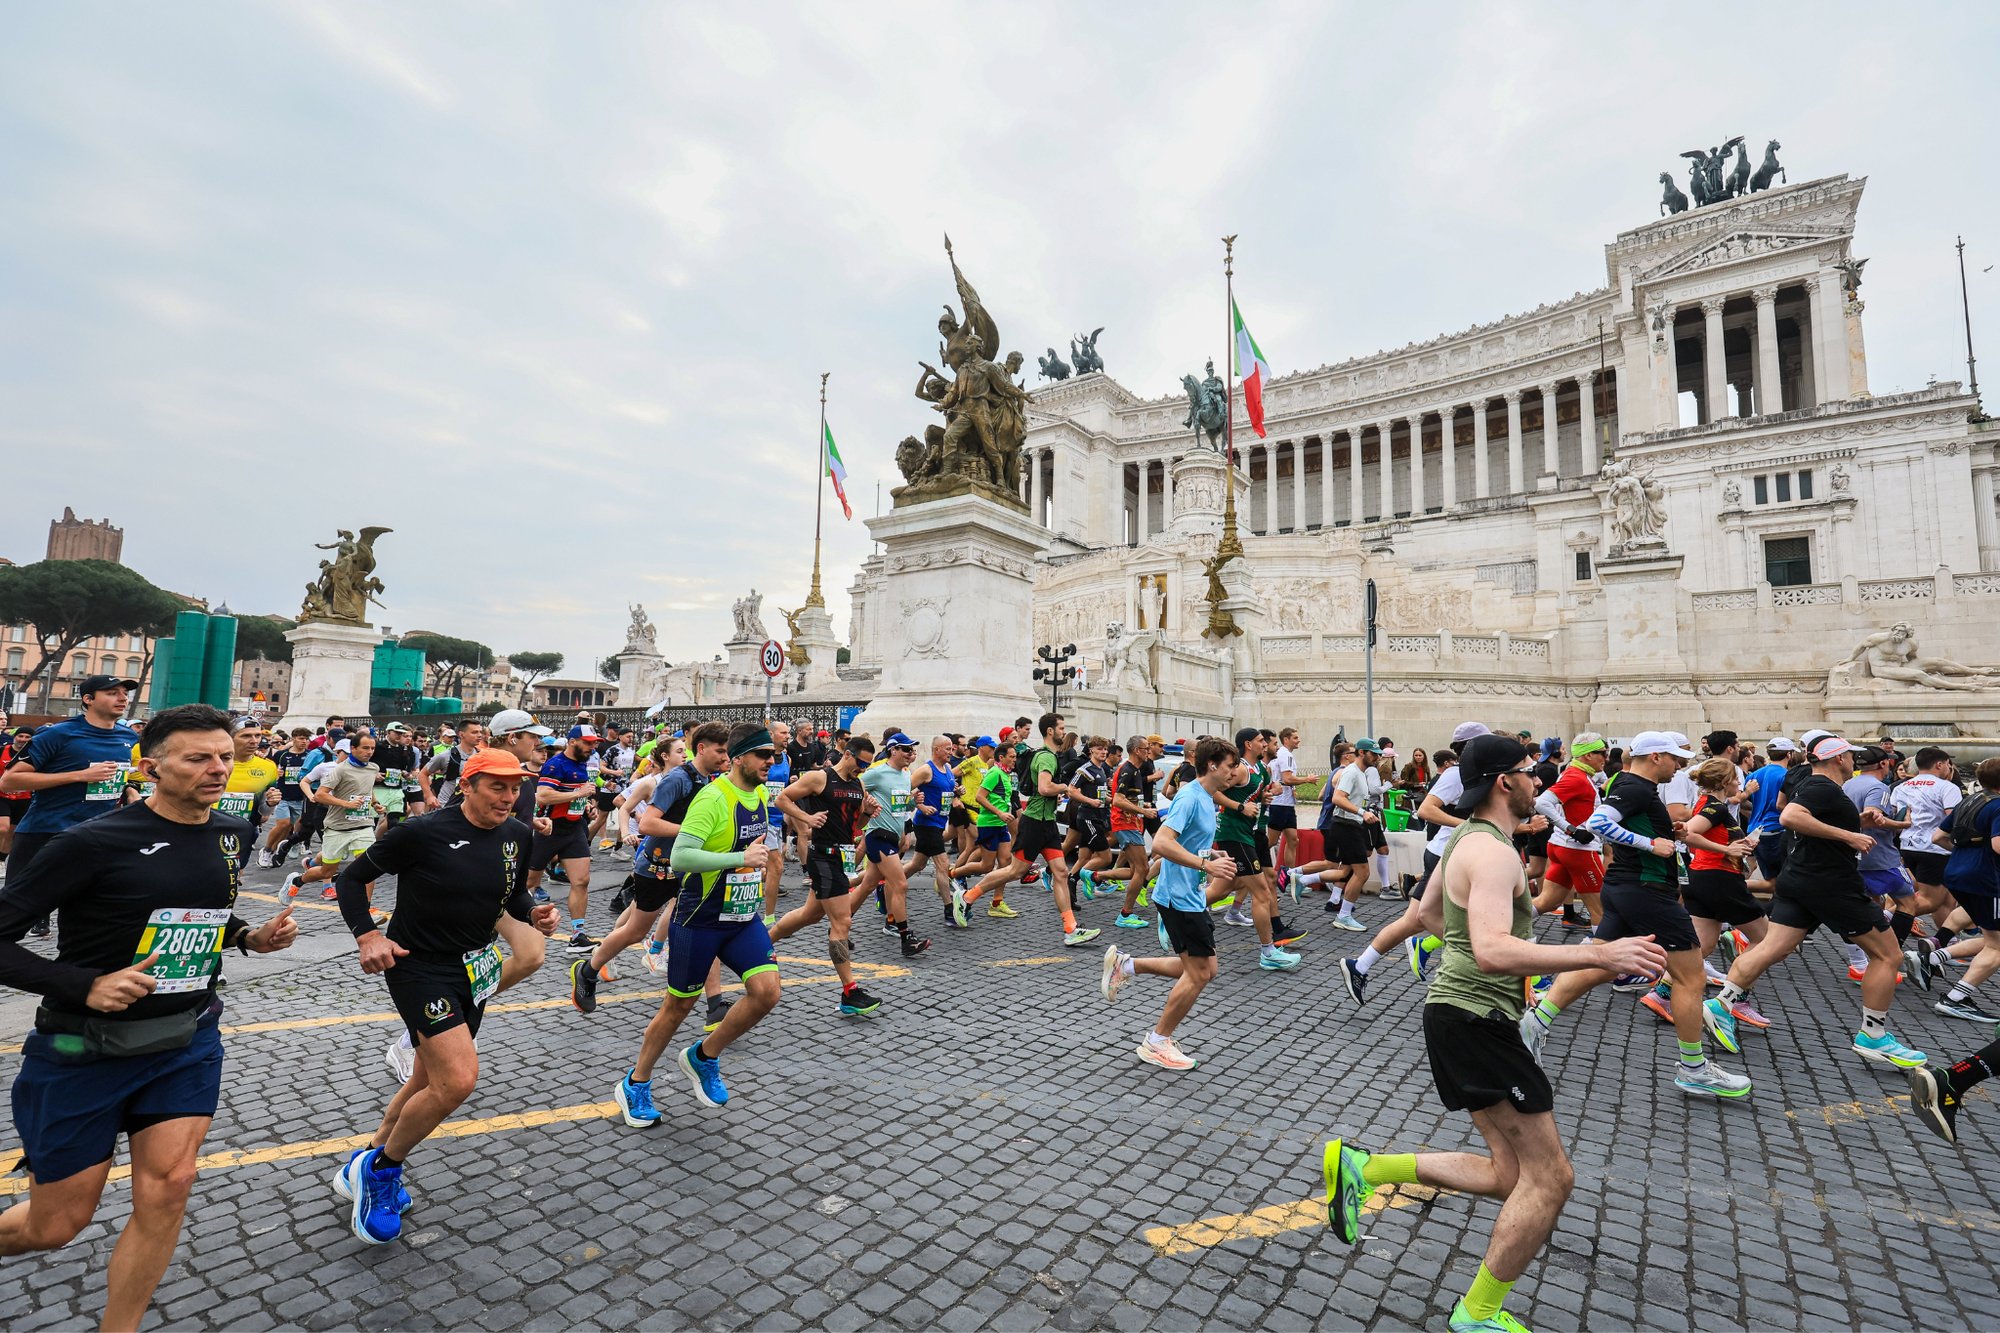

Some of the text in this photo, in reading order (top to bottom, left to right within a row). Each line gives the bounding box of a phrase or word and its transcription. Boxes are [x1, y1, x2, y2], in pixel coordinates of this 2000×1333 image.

[1736, 264, 1799, 286] LIBERTATI
[765, 649, 780, 668] 30
[731, 883, 758, 902] 27082
[152, 927, 218, 955] 28057
[152, 965, 197, 979] 32 B
